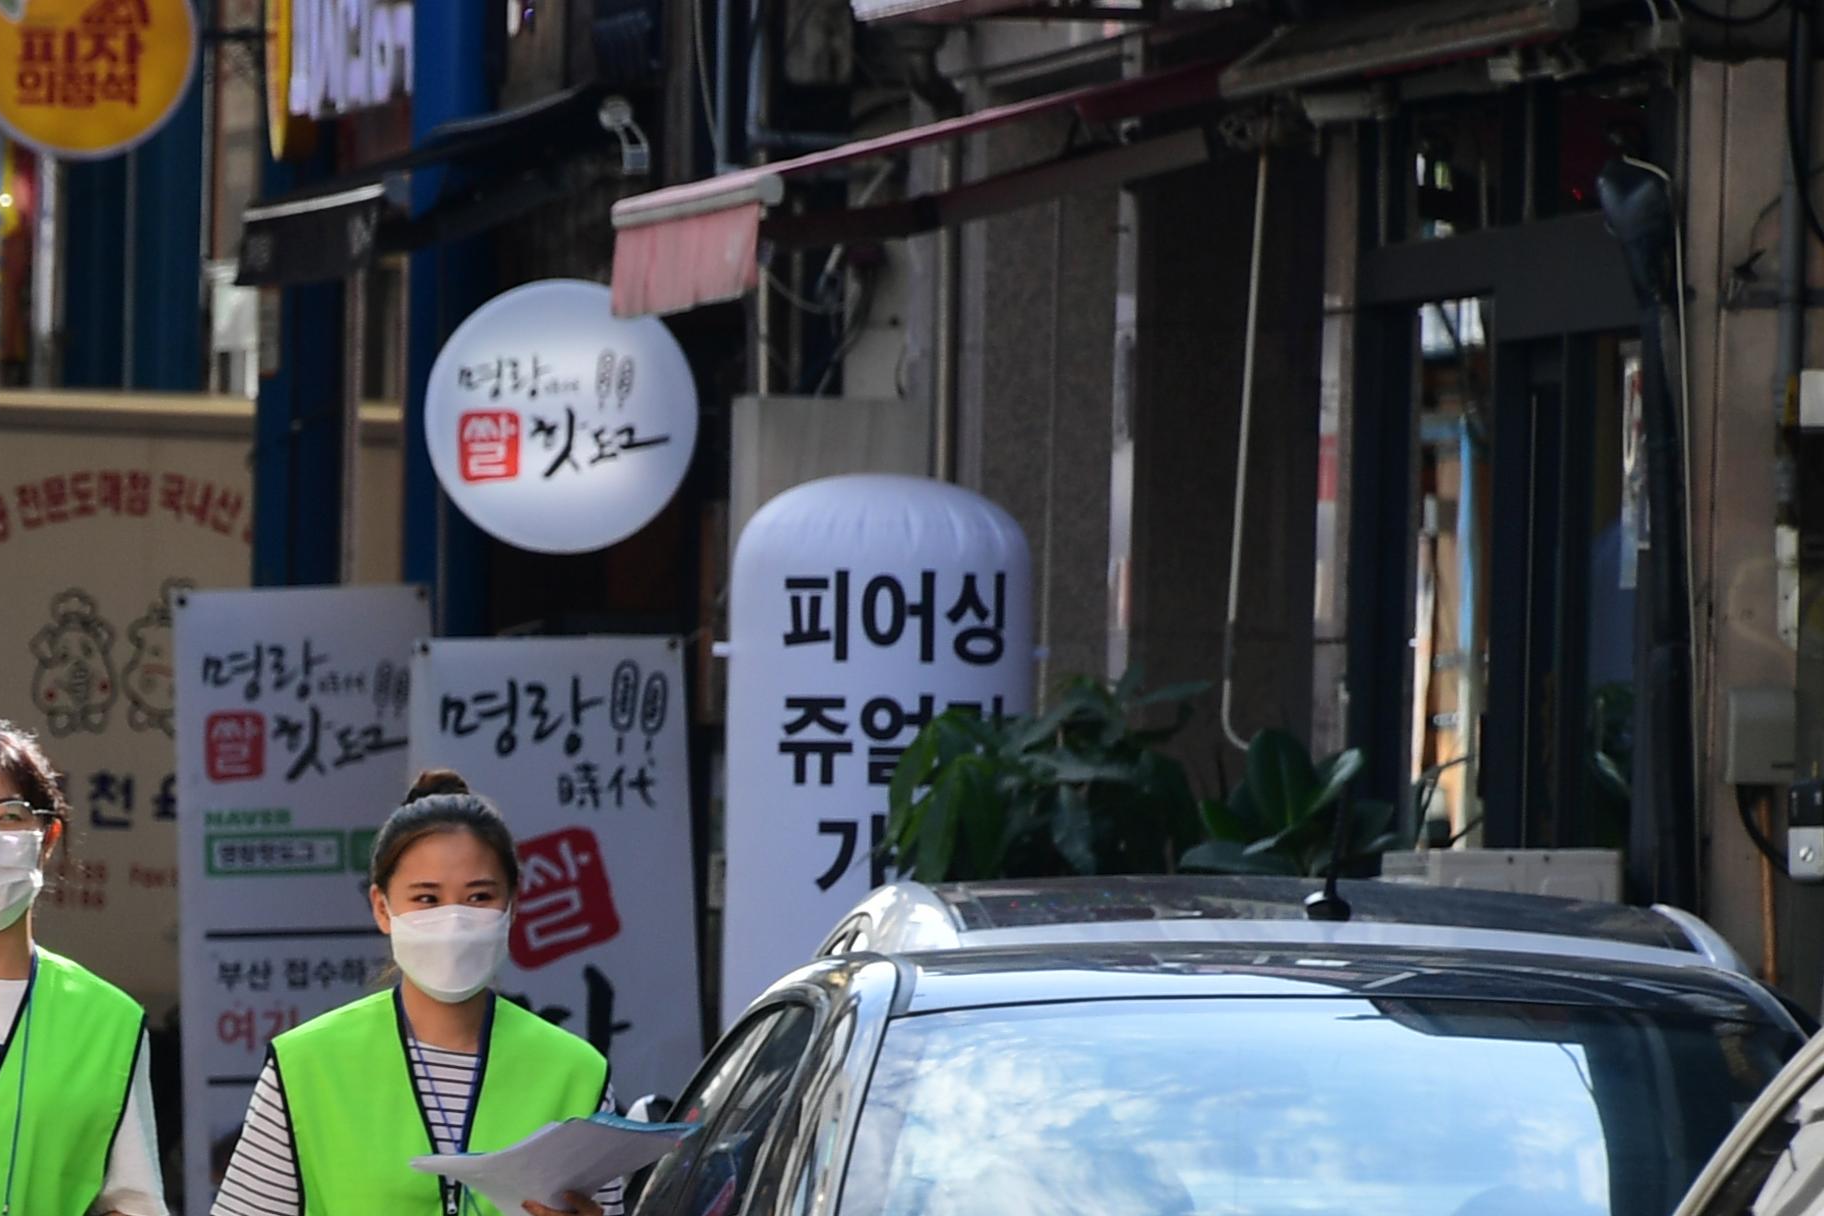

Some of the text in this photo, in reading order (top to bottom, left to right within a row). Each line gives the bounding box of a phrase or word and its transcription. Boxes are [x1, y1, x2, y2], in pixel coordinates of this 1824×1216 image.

[458, 355, 549, 399] 명랑
[461, 411, 518, 479] 쌀
[160, 472, 242, 537] 국내산
[782, 569, 1007, 666] 피어싱
[203, 638, 329, 701] 명랑
[209, 714, 262, 780] 쌀
[440, 676, 602, 757] 명랑
[557, 765, 655, 809] 時代
[217, 960, 273, 991] 부산
